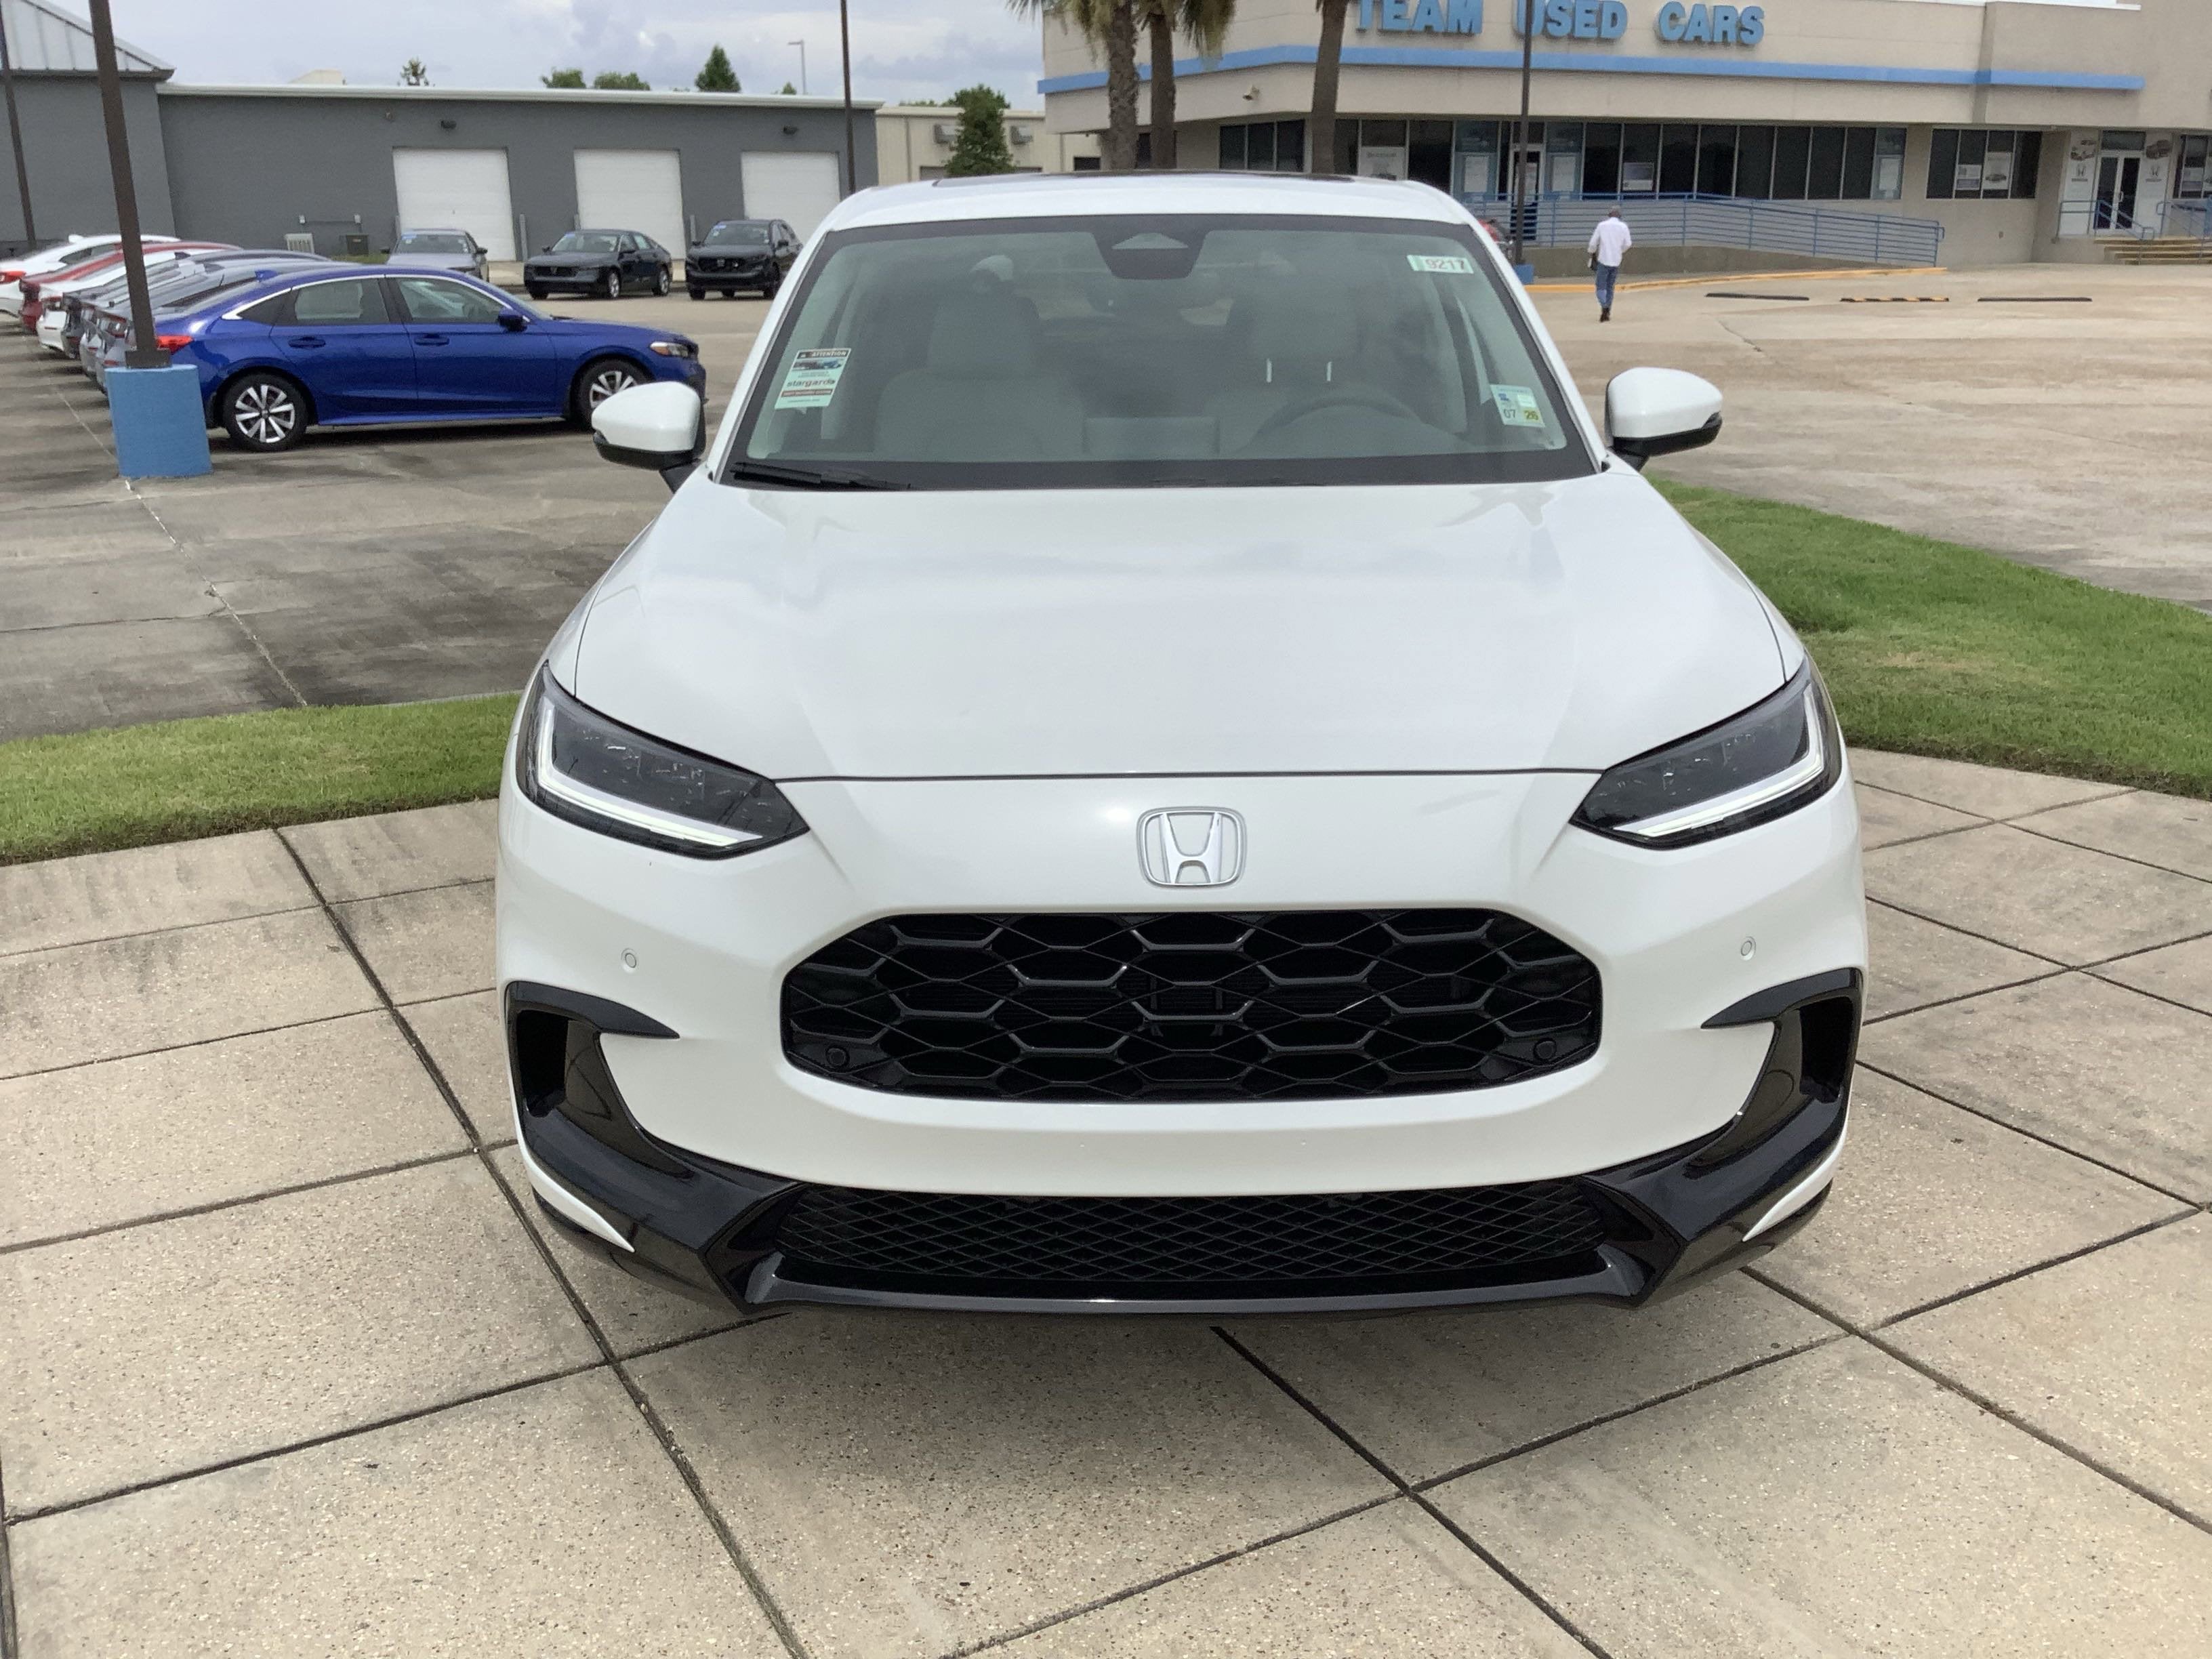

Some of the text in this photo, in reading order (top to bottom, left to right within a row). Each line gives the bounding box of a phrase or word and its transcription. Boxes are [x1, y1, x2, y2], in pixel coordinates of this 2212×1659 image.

[1354, 0, 1764, 44] TEAM USED CARS
[1503, 409, 1516, 419] 07
